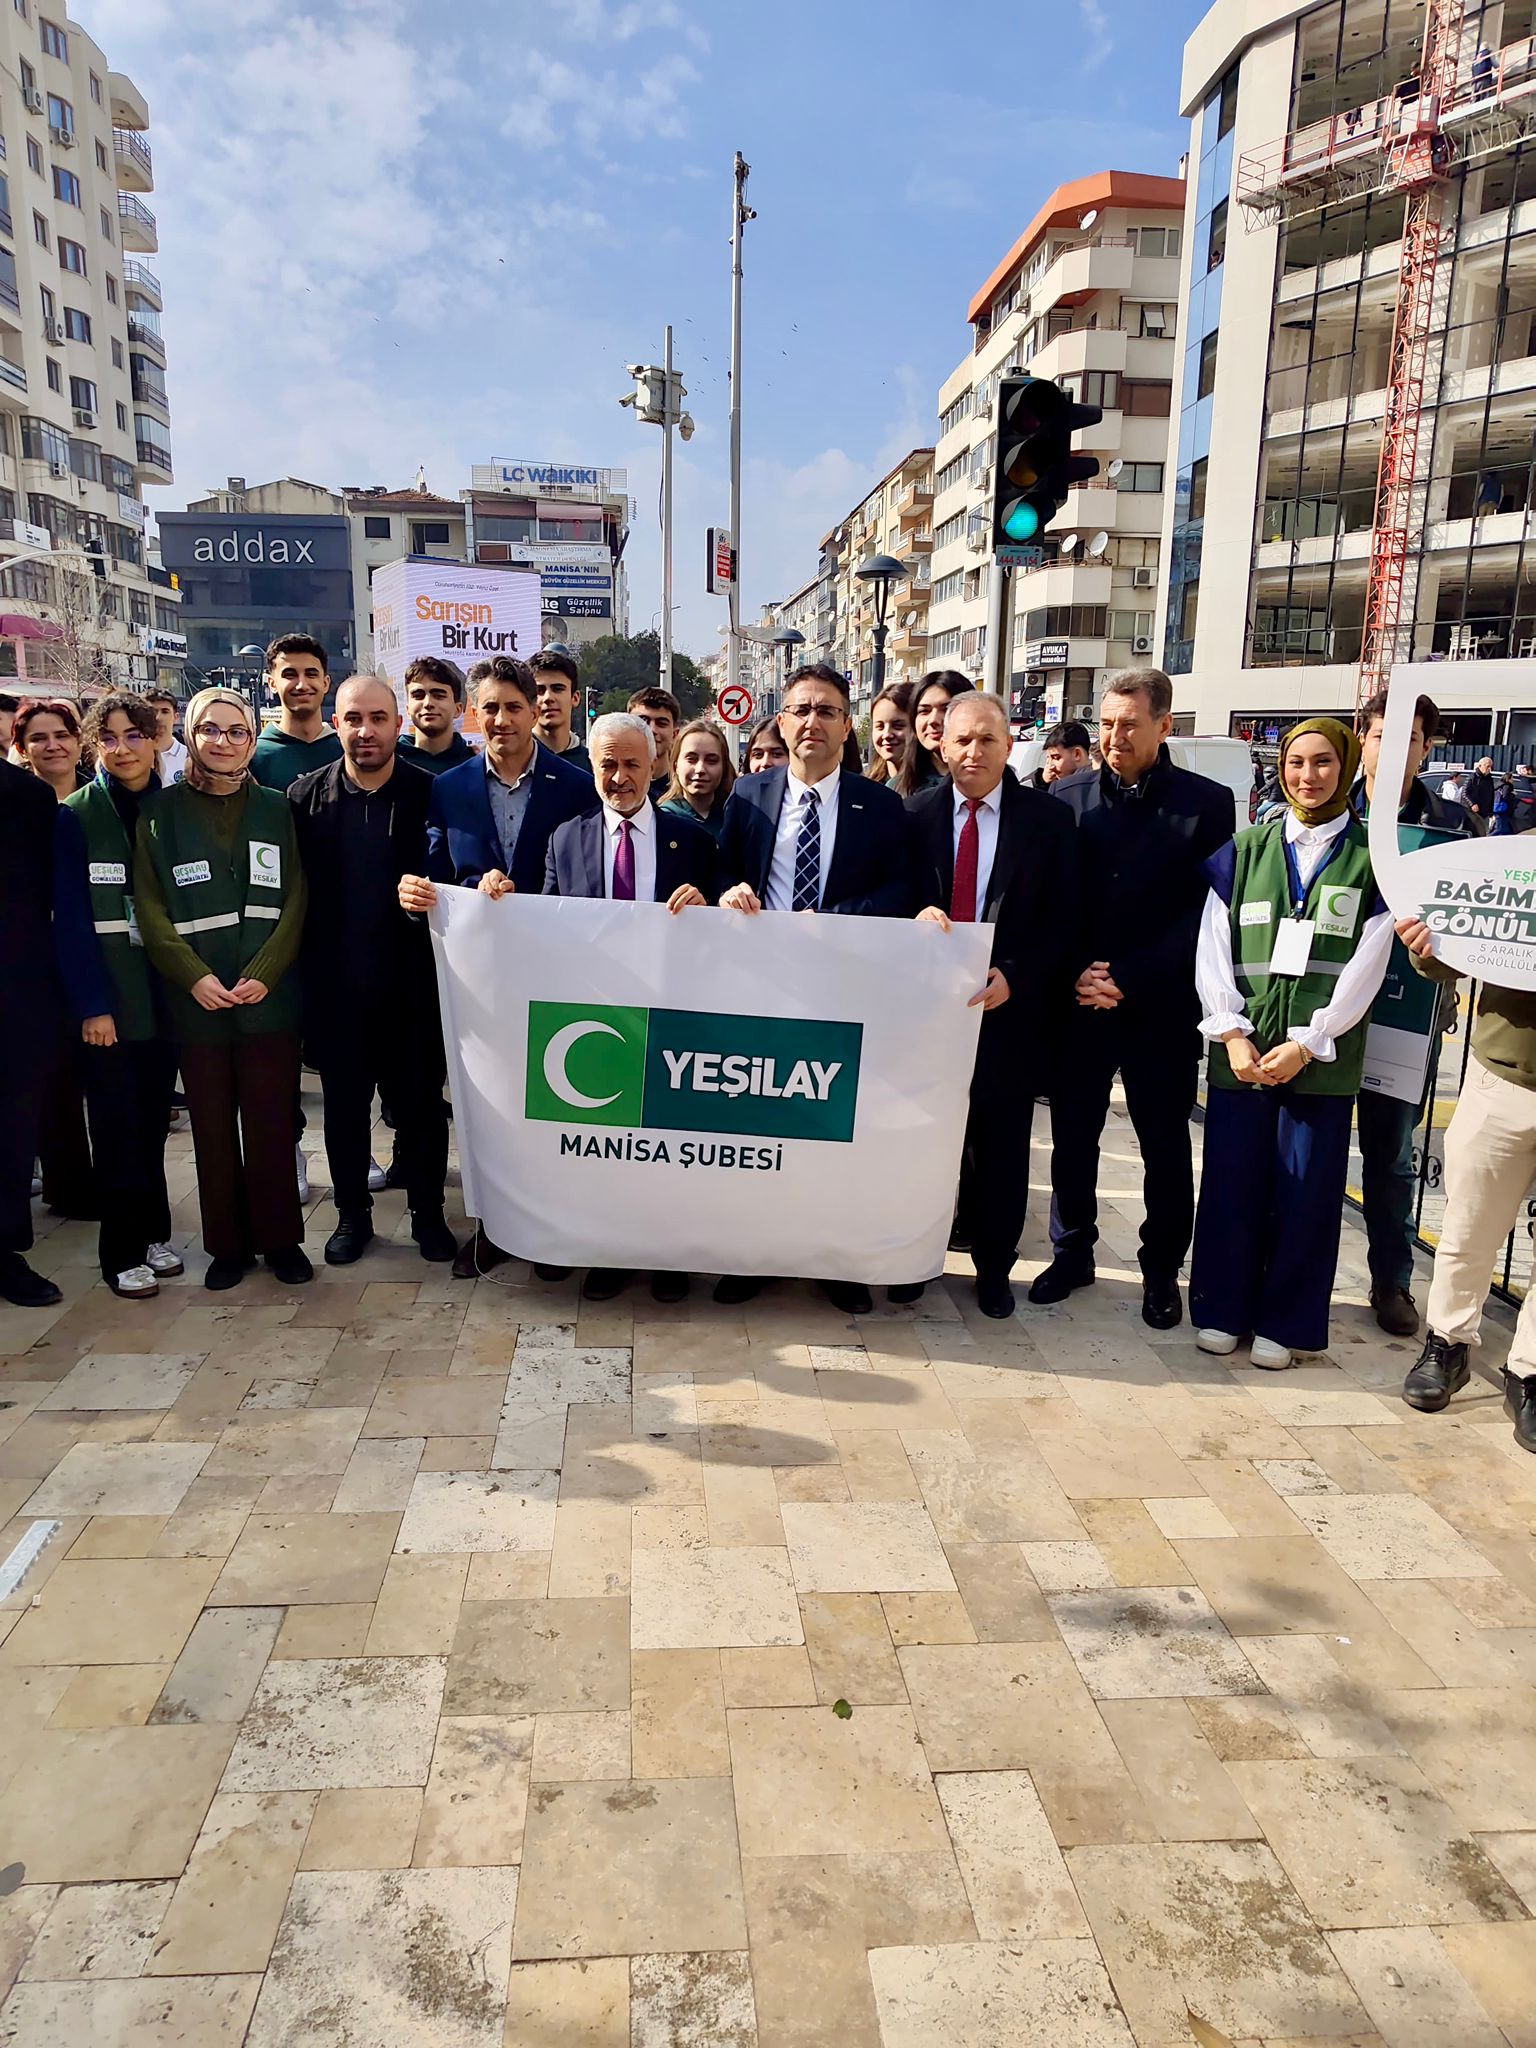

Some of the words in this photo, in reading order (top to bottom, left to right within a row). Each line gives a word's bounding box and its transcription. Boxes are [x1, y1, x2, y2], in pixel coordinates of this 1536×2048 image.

[502, 467, 525, 481] LC
[193, 530, 315, 563] addax
[545, 563, 600, 574] MANİSA'NIN
[415, 594, 493, 628] Sarışın
[541, 597, 559, 609] ite
[566, 598, 603, 606] Güzellik
[569, 606, 601, 615] Salonu
[442, 623, 471, 649] Bir
[474, 627, 518, 652] Kurt
[1042, 645, 1067, 654] AVUKAT
[1434, 878, 1536, 909] BAĞIM
[1426, 906, 1536, 942] GÖNÜL
[1479, 943, 1487, 952] 5
[1490, 944, 1534, 958] ARALIK
[662, 1049, 843, 1100] YEŞİLAY
[559, 1132, 671, 1164] MANİSA
[679, 1142, 783, 1172] ŞUBESİ
